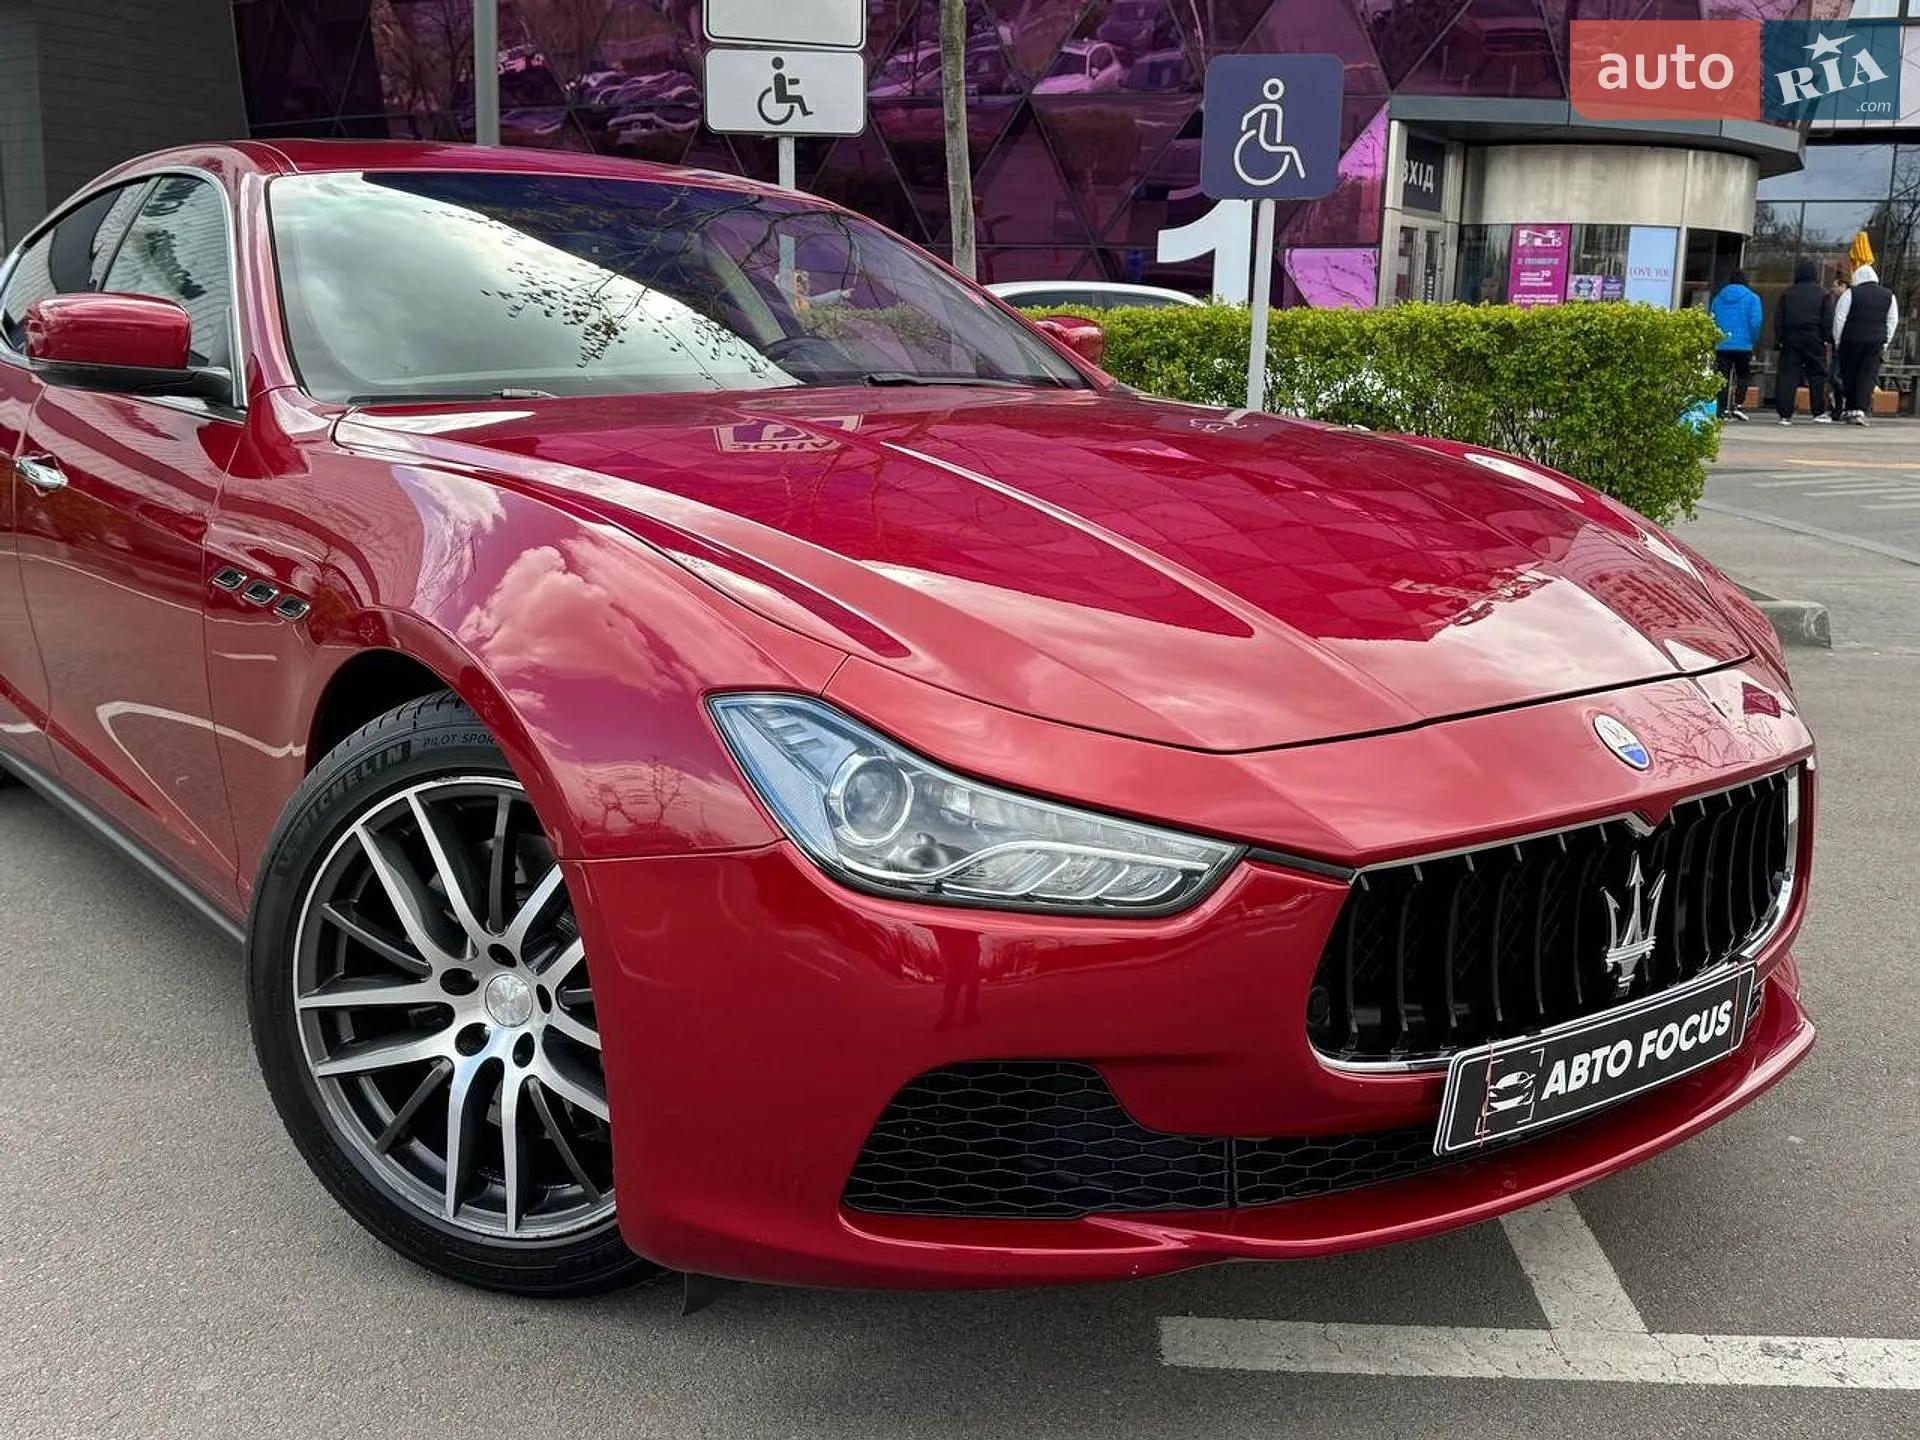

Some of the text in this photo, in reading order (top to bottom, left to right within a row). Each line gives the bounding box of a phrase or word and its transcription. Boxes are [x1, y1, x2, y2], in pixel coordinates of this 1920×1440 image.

[1157, 199, 1253, 306] 1
[286, 743, 403, 846] MICHELIN
[1637, 1000, 1733, 1068] FOCUS
